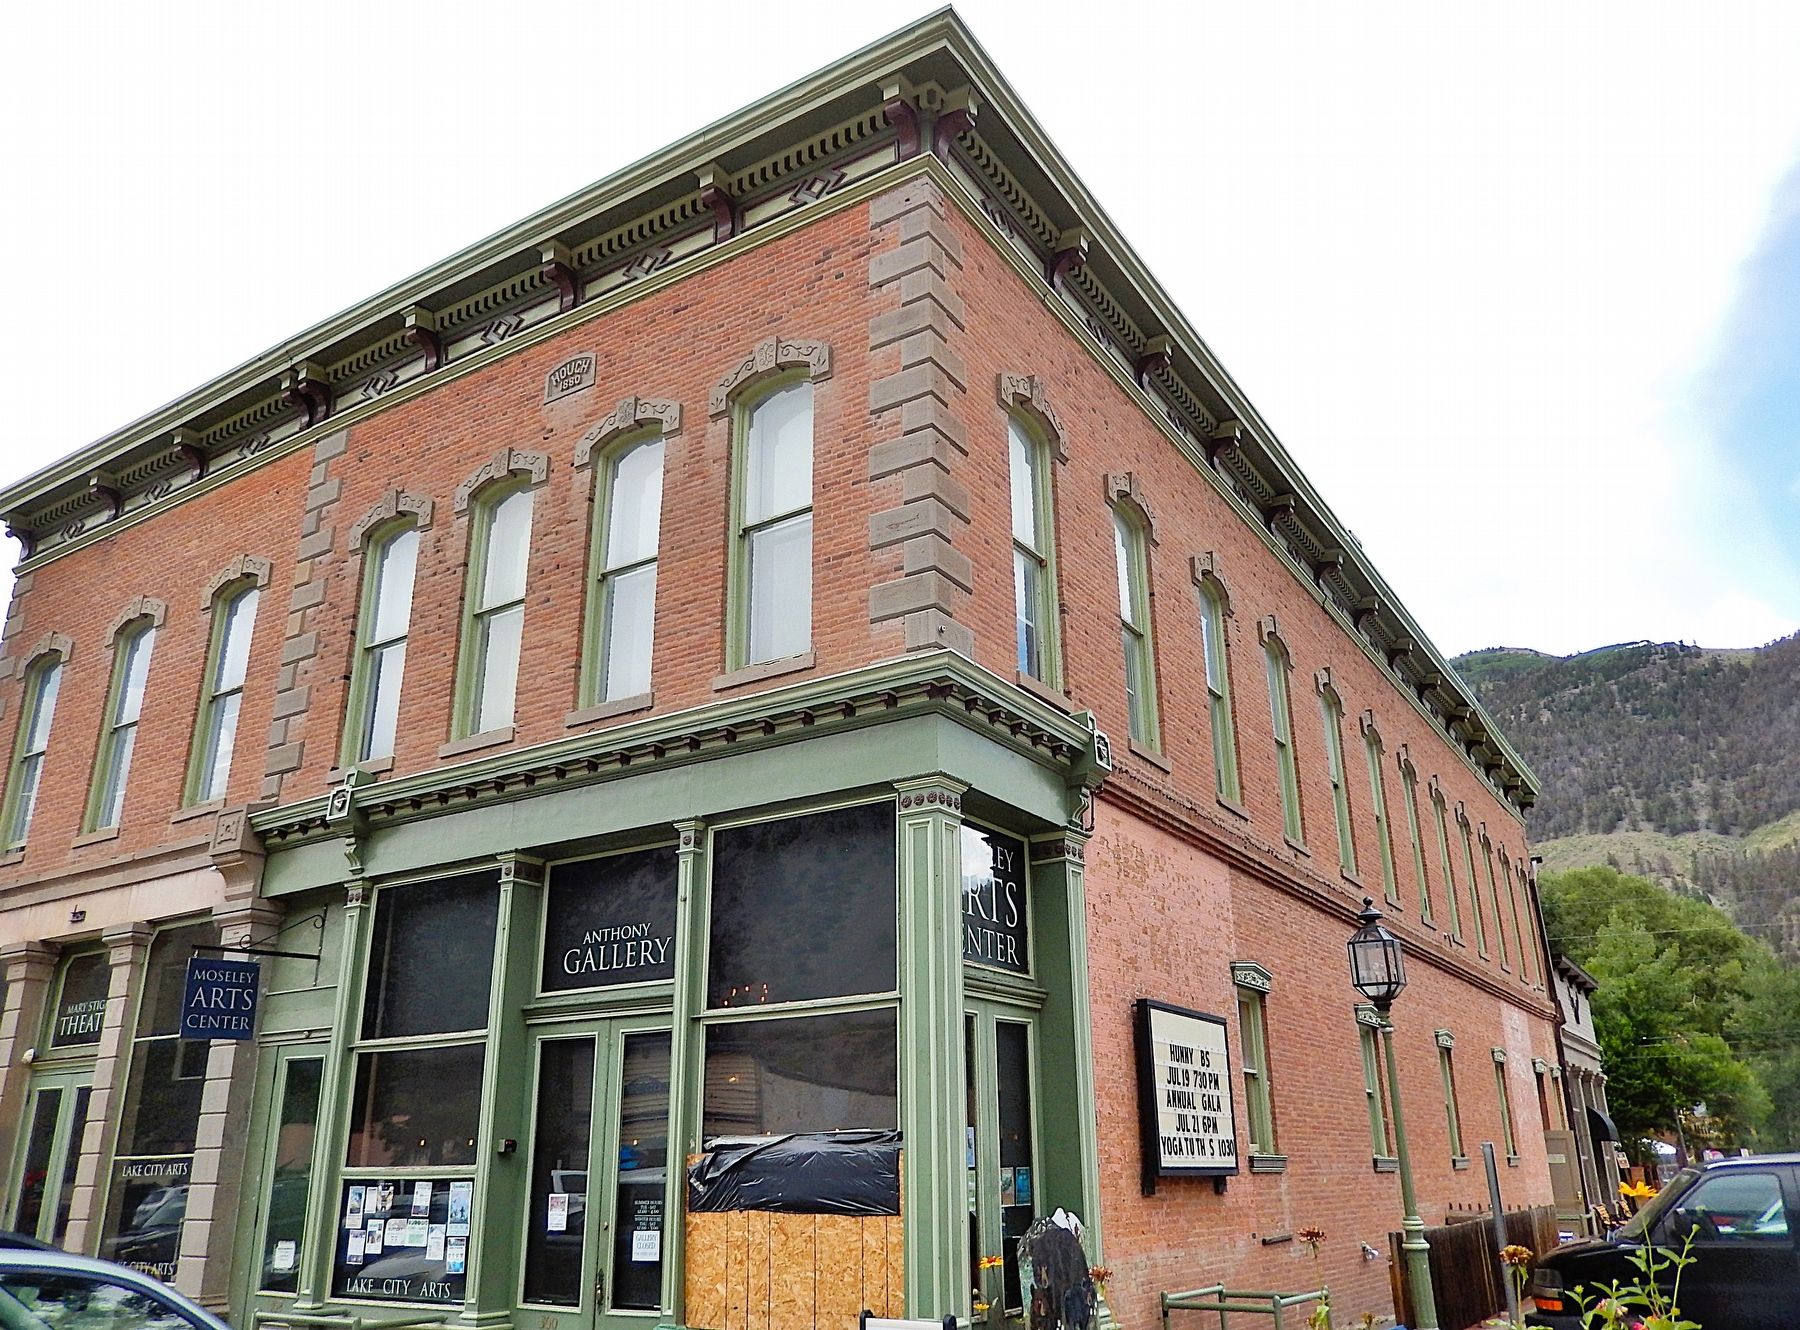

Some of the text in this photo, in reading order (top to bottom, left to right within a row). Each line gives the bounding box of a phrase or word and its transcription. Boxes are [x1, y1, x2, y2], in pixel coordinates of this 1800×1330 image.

[993, 846, 1014, 872] EY
[961, 877, 1018, 928] RTS
[582, 922, 651, 945] ANTHONY
[961, 923, 1021, 966] NTER
[563, 936, 672, 974] GALLERY
[193, 969, 255, 984] MOSELEY
[190, 986, 254, 1011] ARTS
[186, 1013, 250, 1030] CENTER
[1200, 1050, 1211, 1068] BS
[1166, 1089, 1222, 1113] ANNUAL GALA
[1175, 1113, 1219, 1134] JUL 21 6PM
[1218, 1138, 1235, 1157] 1030
[122, 1162, 188, 1177] LAKE CITY ARTS
[346, 1277, 451, 1299] LAKE CITY ARTS
